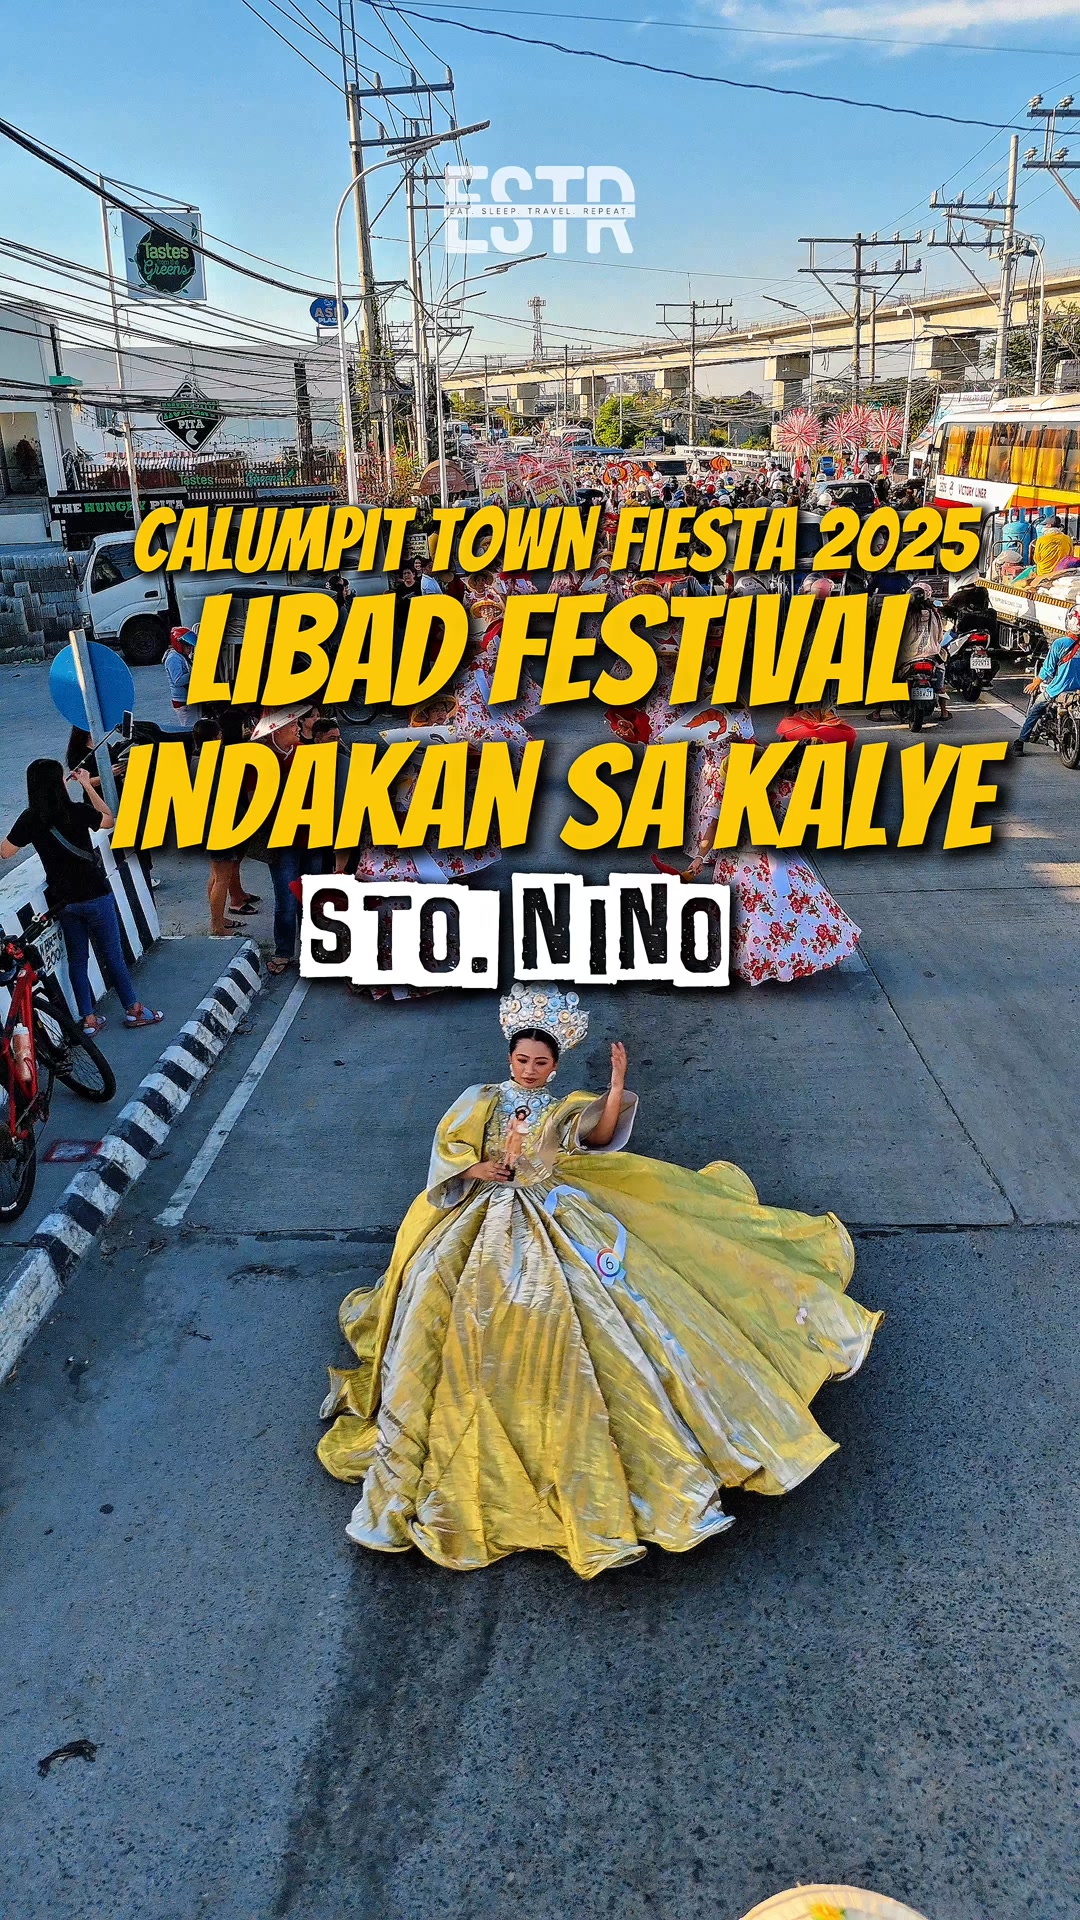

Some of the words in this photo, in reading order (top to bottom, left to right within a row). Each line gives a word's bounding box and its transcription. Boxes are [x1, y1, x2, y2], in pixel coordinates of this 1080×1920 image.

[144, 242, 190, 259] Tastes
[143, 259, 191, 281] Greens
[177, 419, 205, 429] PITA
[178, 474, 215, 486] Tastes
[215, 477, 232, 485] from
[51, 503, 83, 514] THE
[605, 1256, 614, 1270] 6
